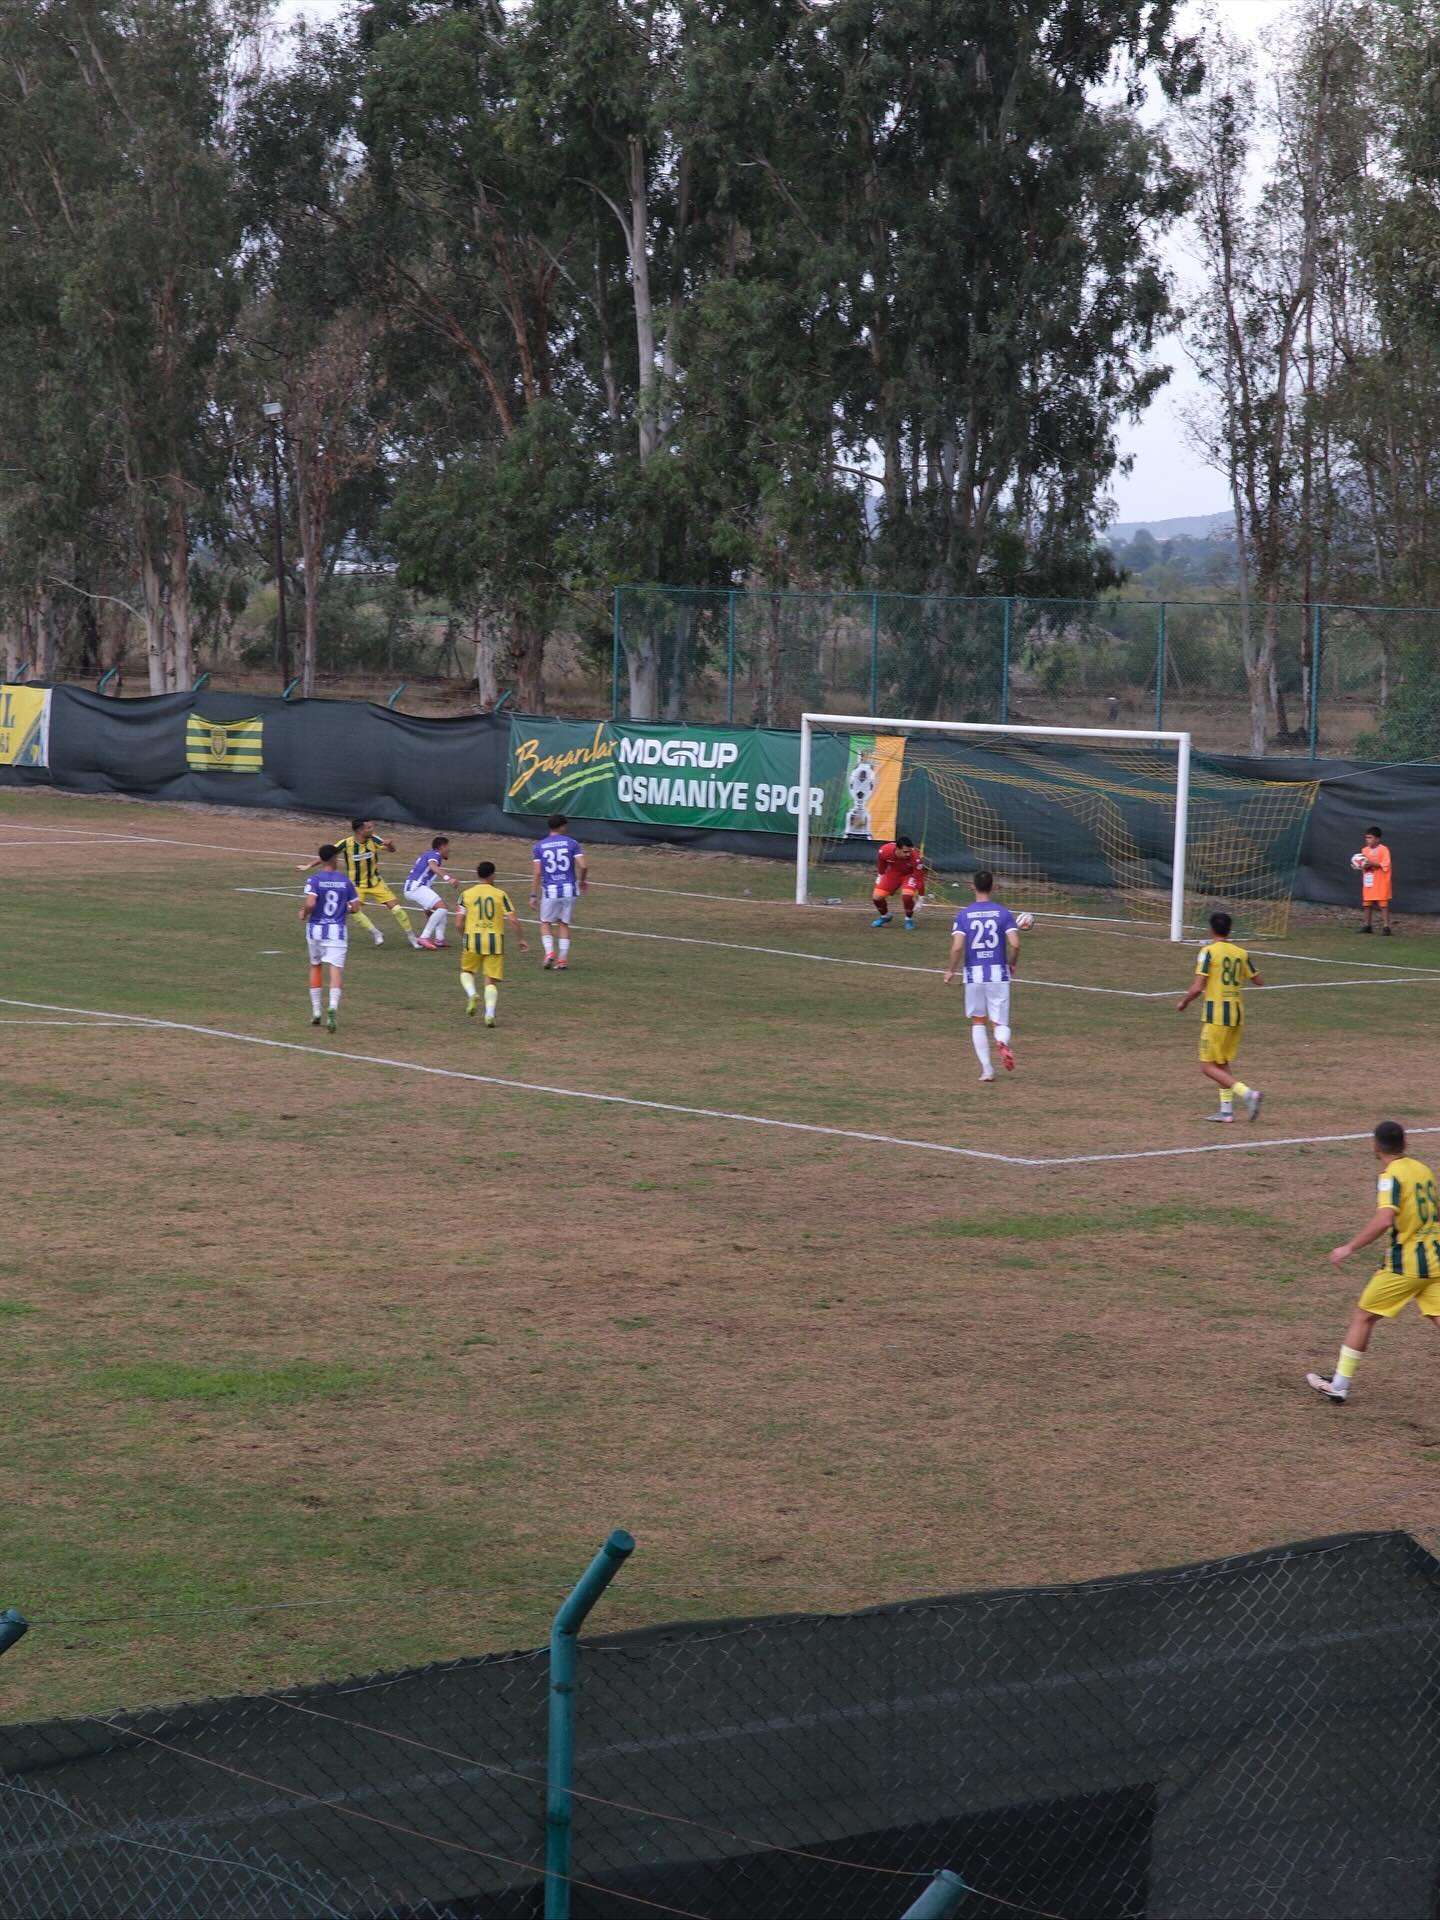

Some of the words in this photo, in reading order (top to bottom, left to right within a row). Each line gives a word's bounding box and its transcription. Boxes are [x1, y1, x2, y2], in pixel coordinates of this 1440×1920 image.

[509, 722, 617, 796] Başarılar
[618, 736, 738, 768] MDGRUP
[617, 773, 749, 810] OSMANİYE
[755, 782, 825, 817] SPOR
[542, 848, 570, 873] 35
[323, 890, 339, 916] 8
[474, 896, 495, 920] 10
[970, 919, 999, 949] 23
[1222, 956, 1241, 985] 80
